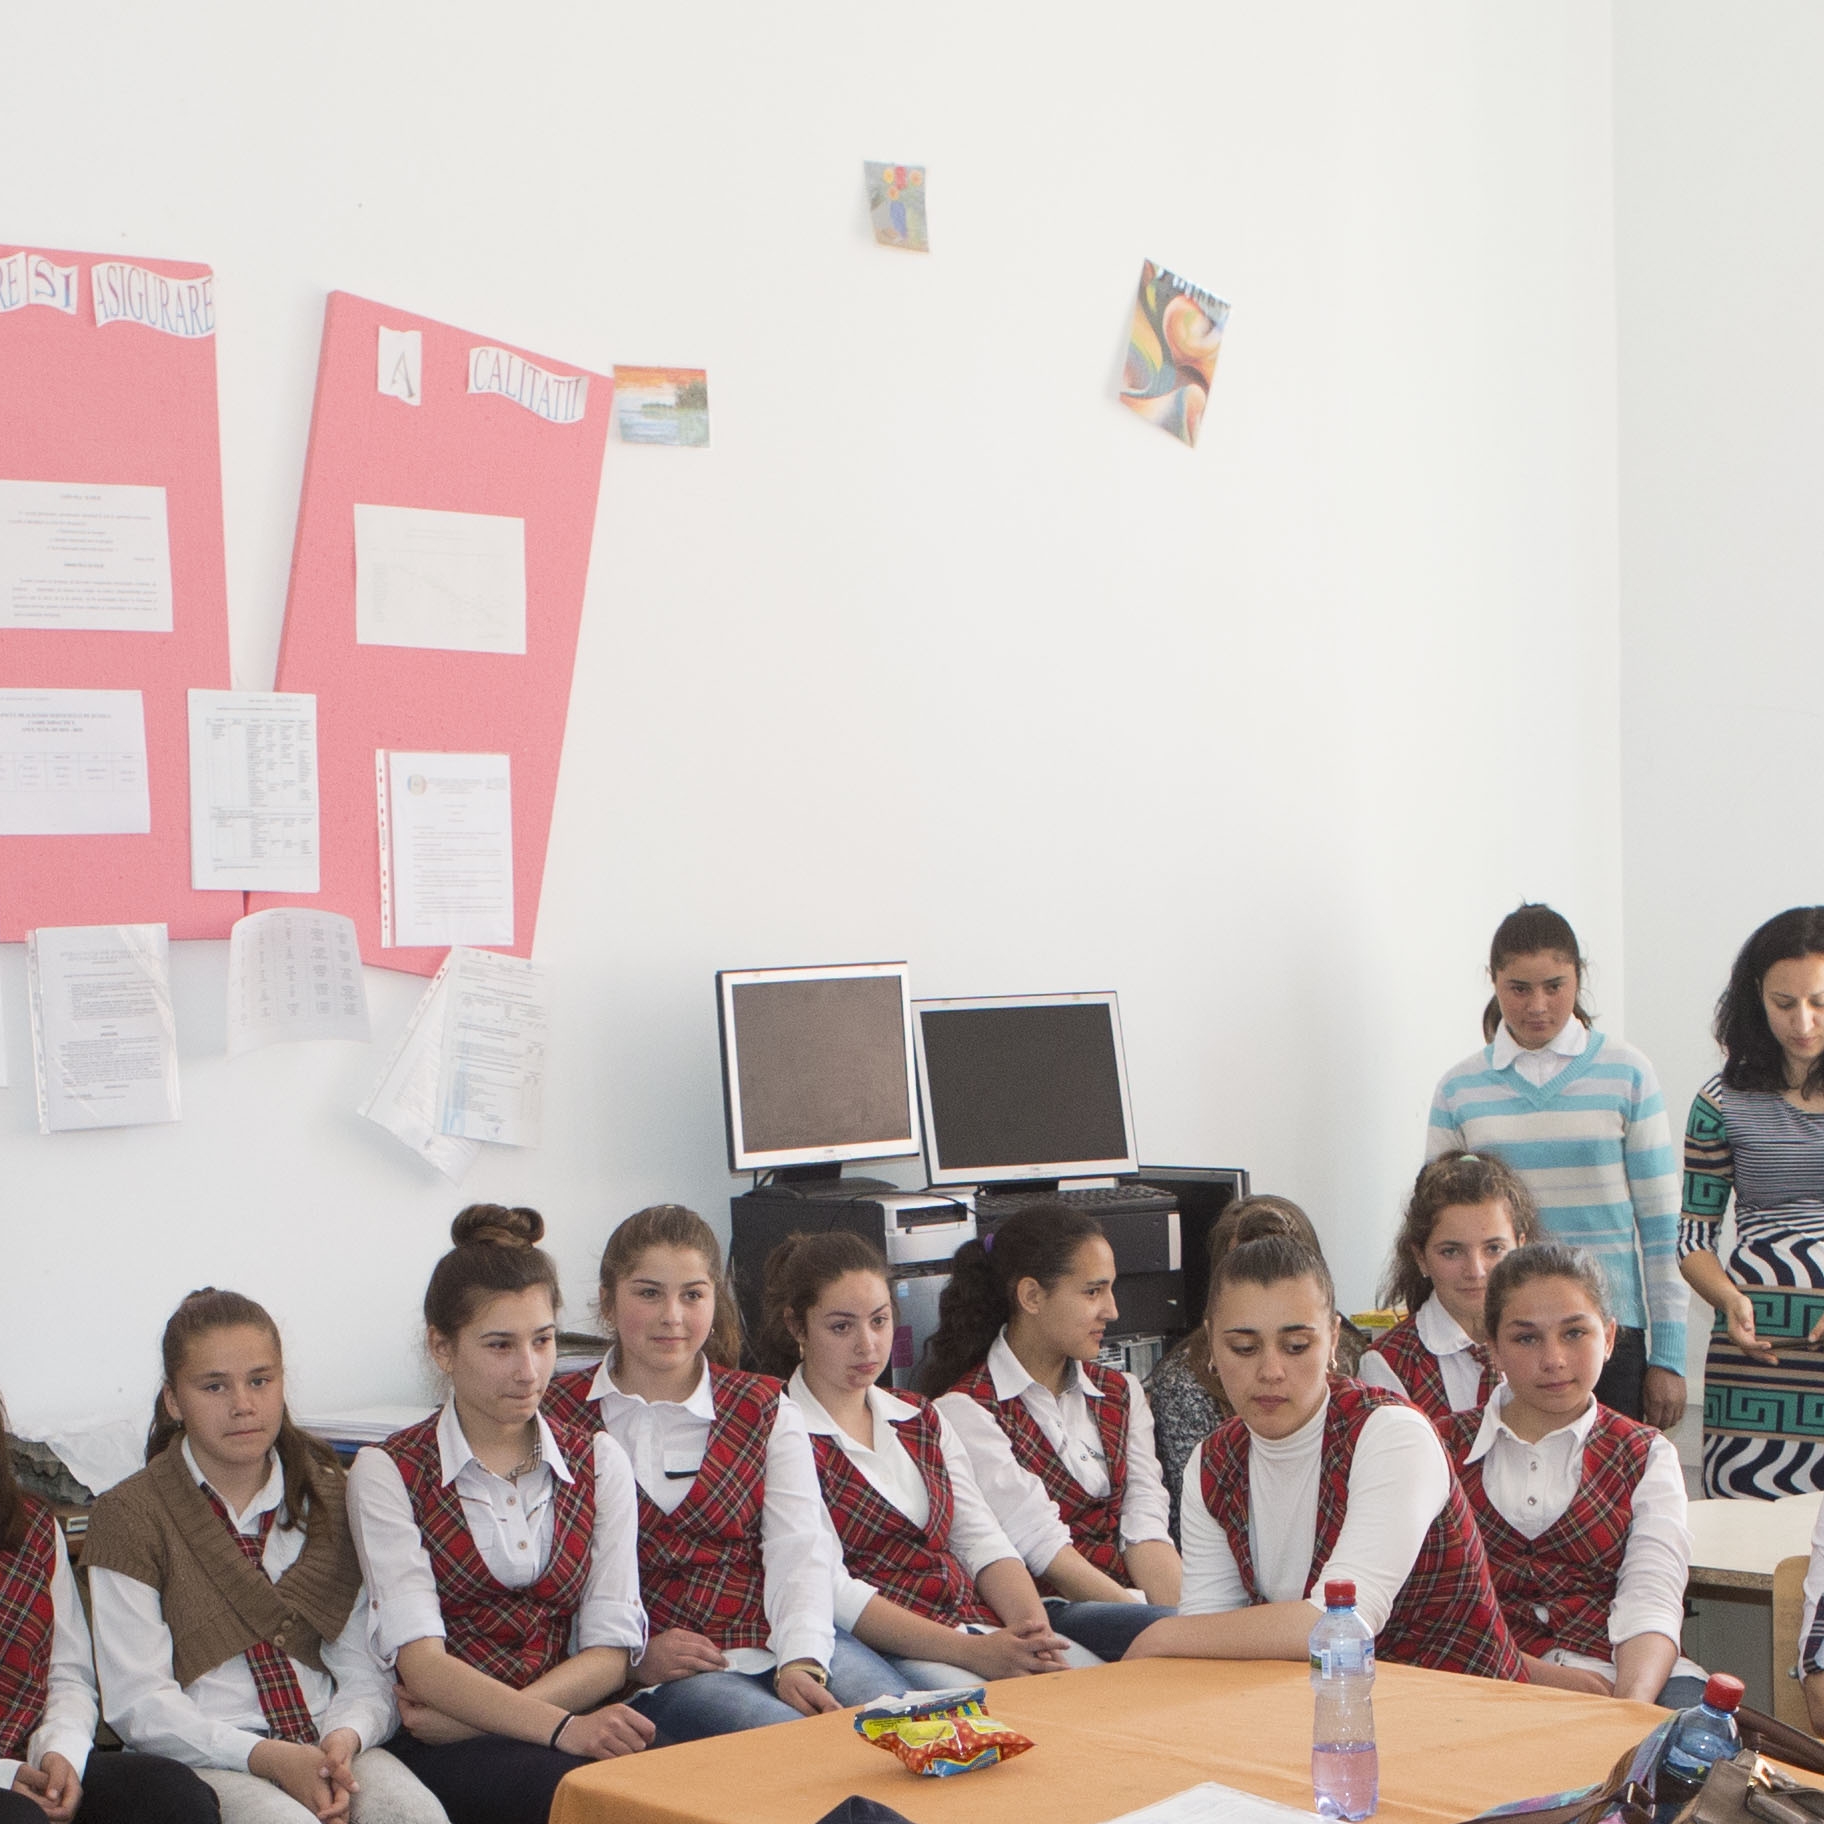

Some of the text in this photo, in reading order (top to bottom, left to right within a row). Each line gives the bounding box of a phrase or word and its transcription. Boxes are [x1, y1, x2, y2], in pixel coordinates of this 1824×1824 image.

[34, 259, 73, 309] SI
[96, 264, 215, 336] ASIGURARE
[390, 351, 417, 399] A
